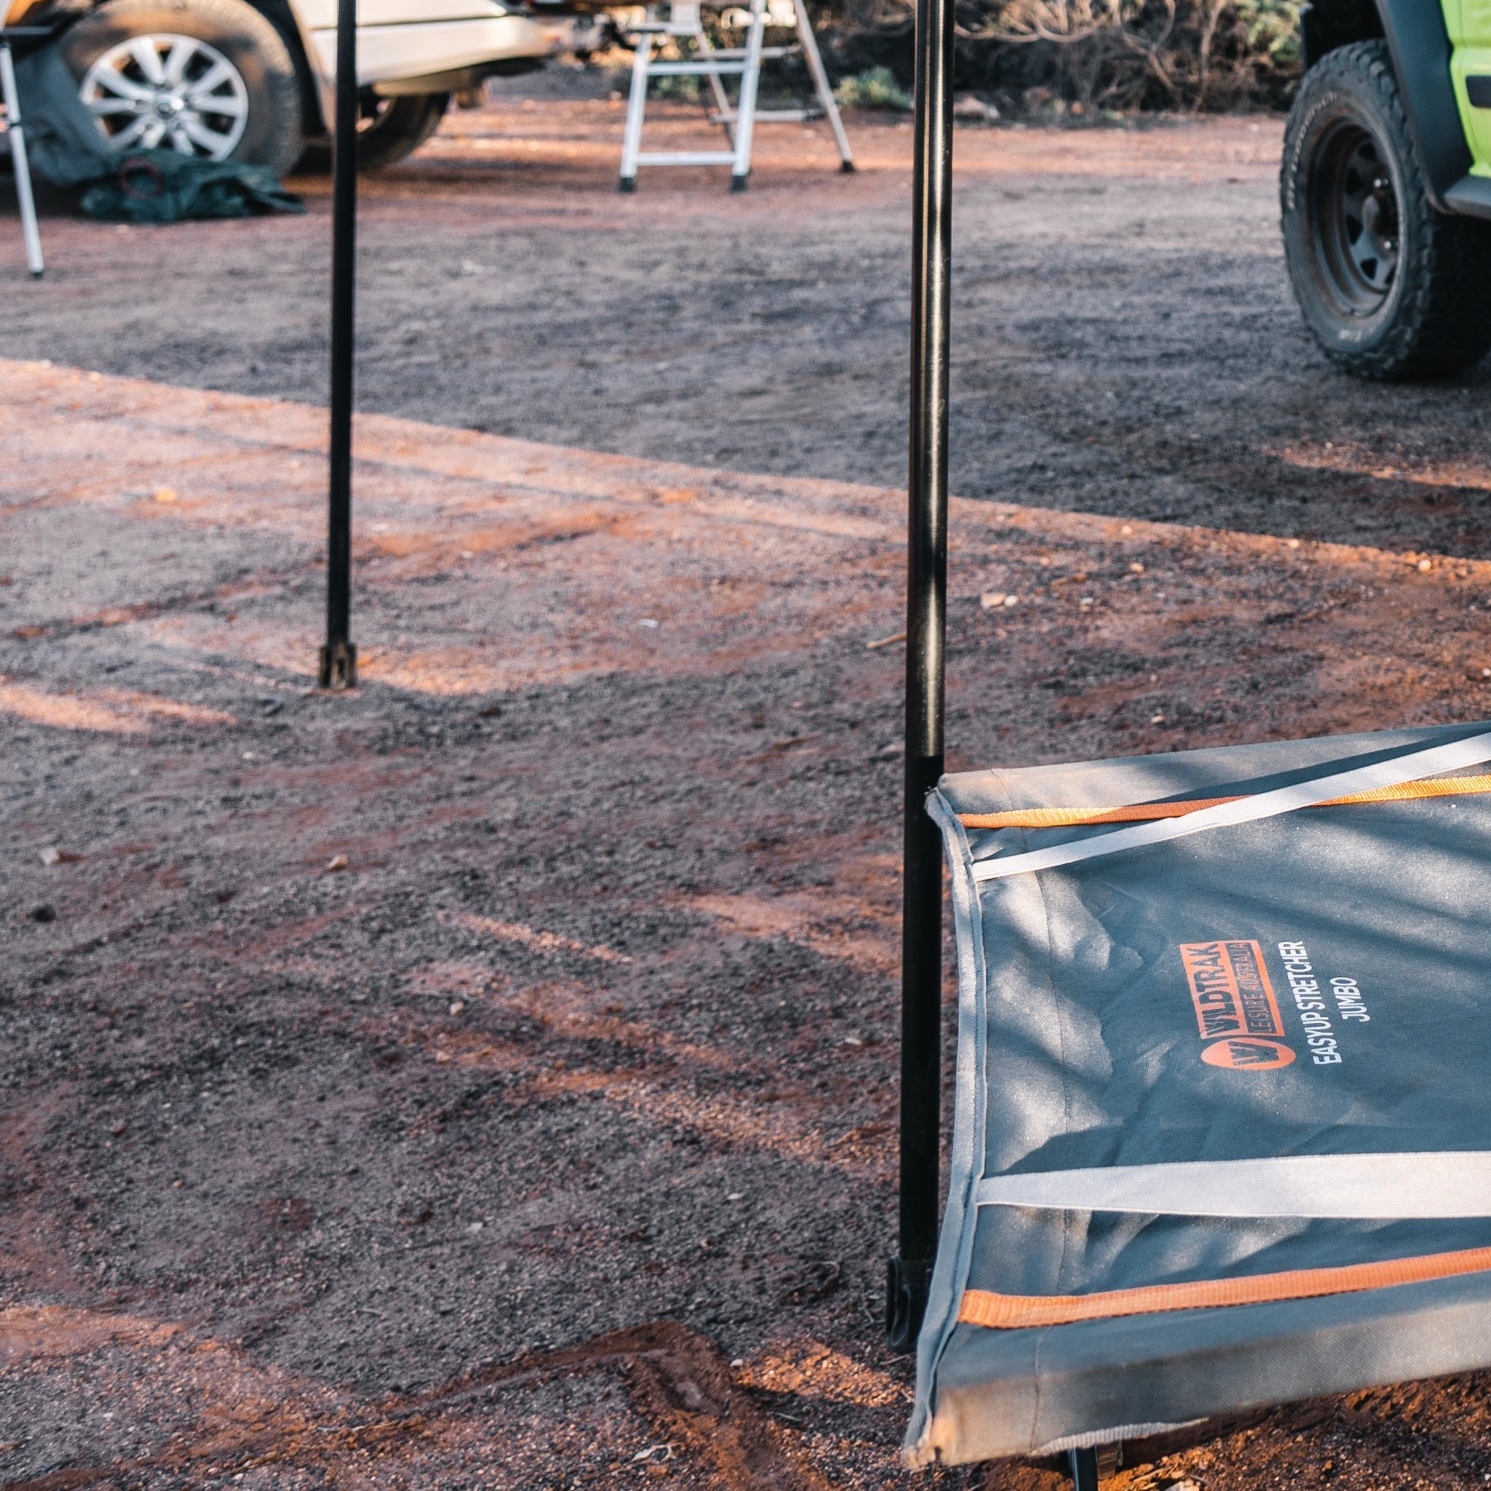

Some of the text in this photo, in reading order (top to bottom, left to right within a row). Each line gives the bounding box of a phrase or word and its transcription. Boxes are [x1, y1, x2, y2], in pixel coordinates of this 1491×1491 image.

[1187, 941, 1241, 1037] WILDTRAK
[1226, 942, 1277, 1034] LEISURE AUSTRALIA
[1278, 940, 1326, 1011] STRETCHER
[1330, 976, 1371, 1023] JUMBO
